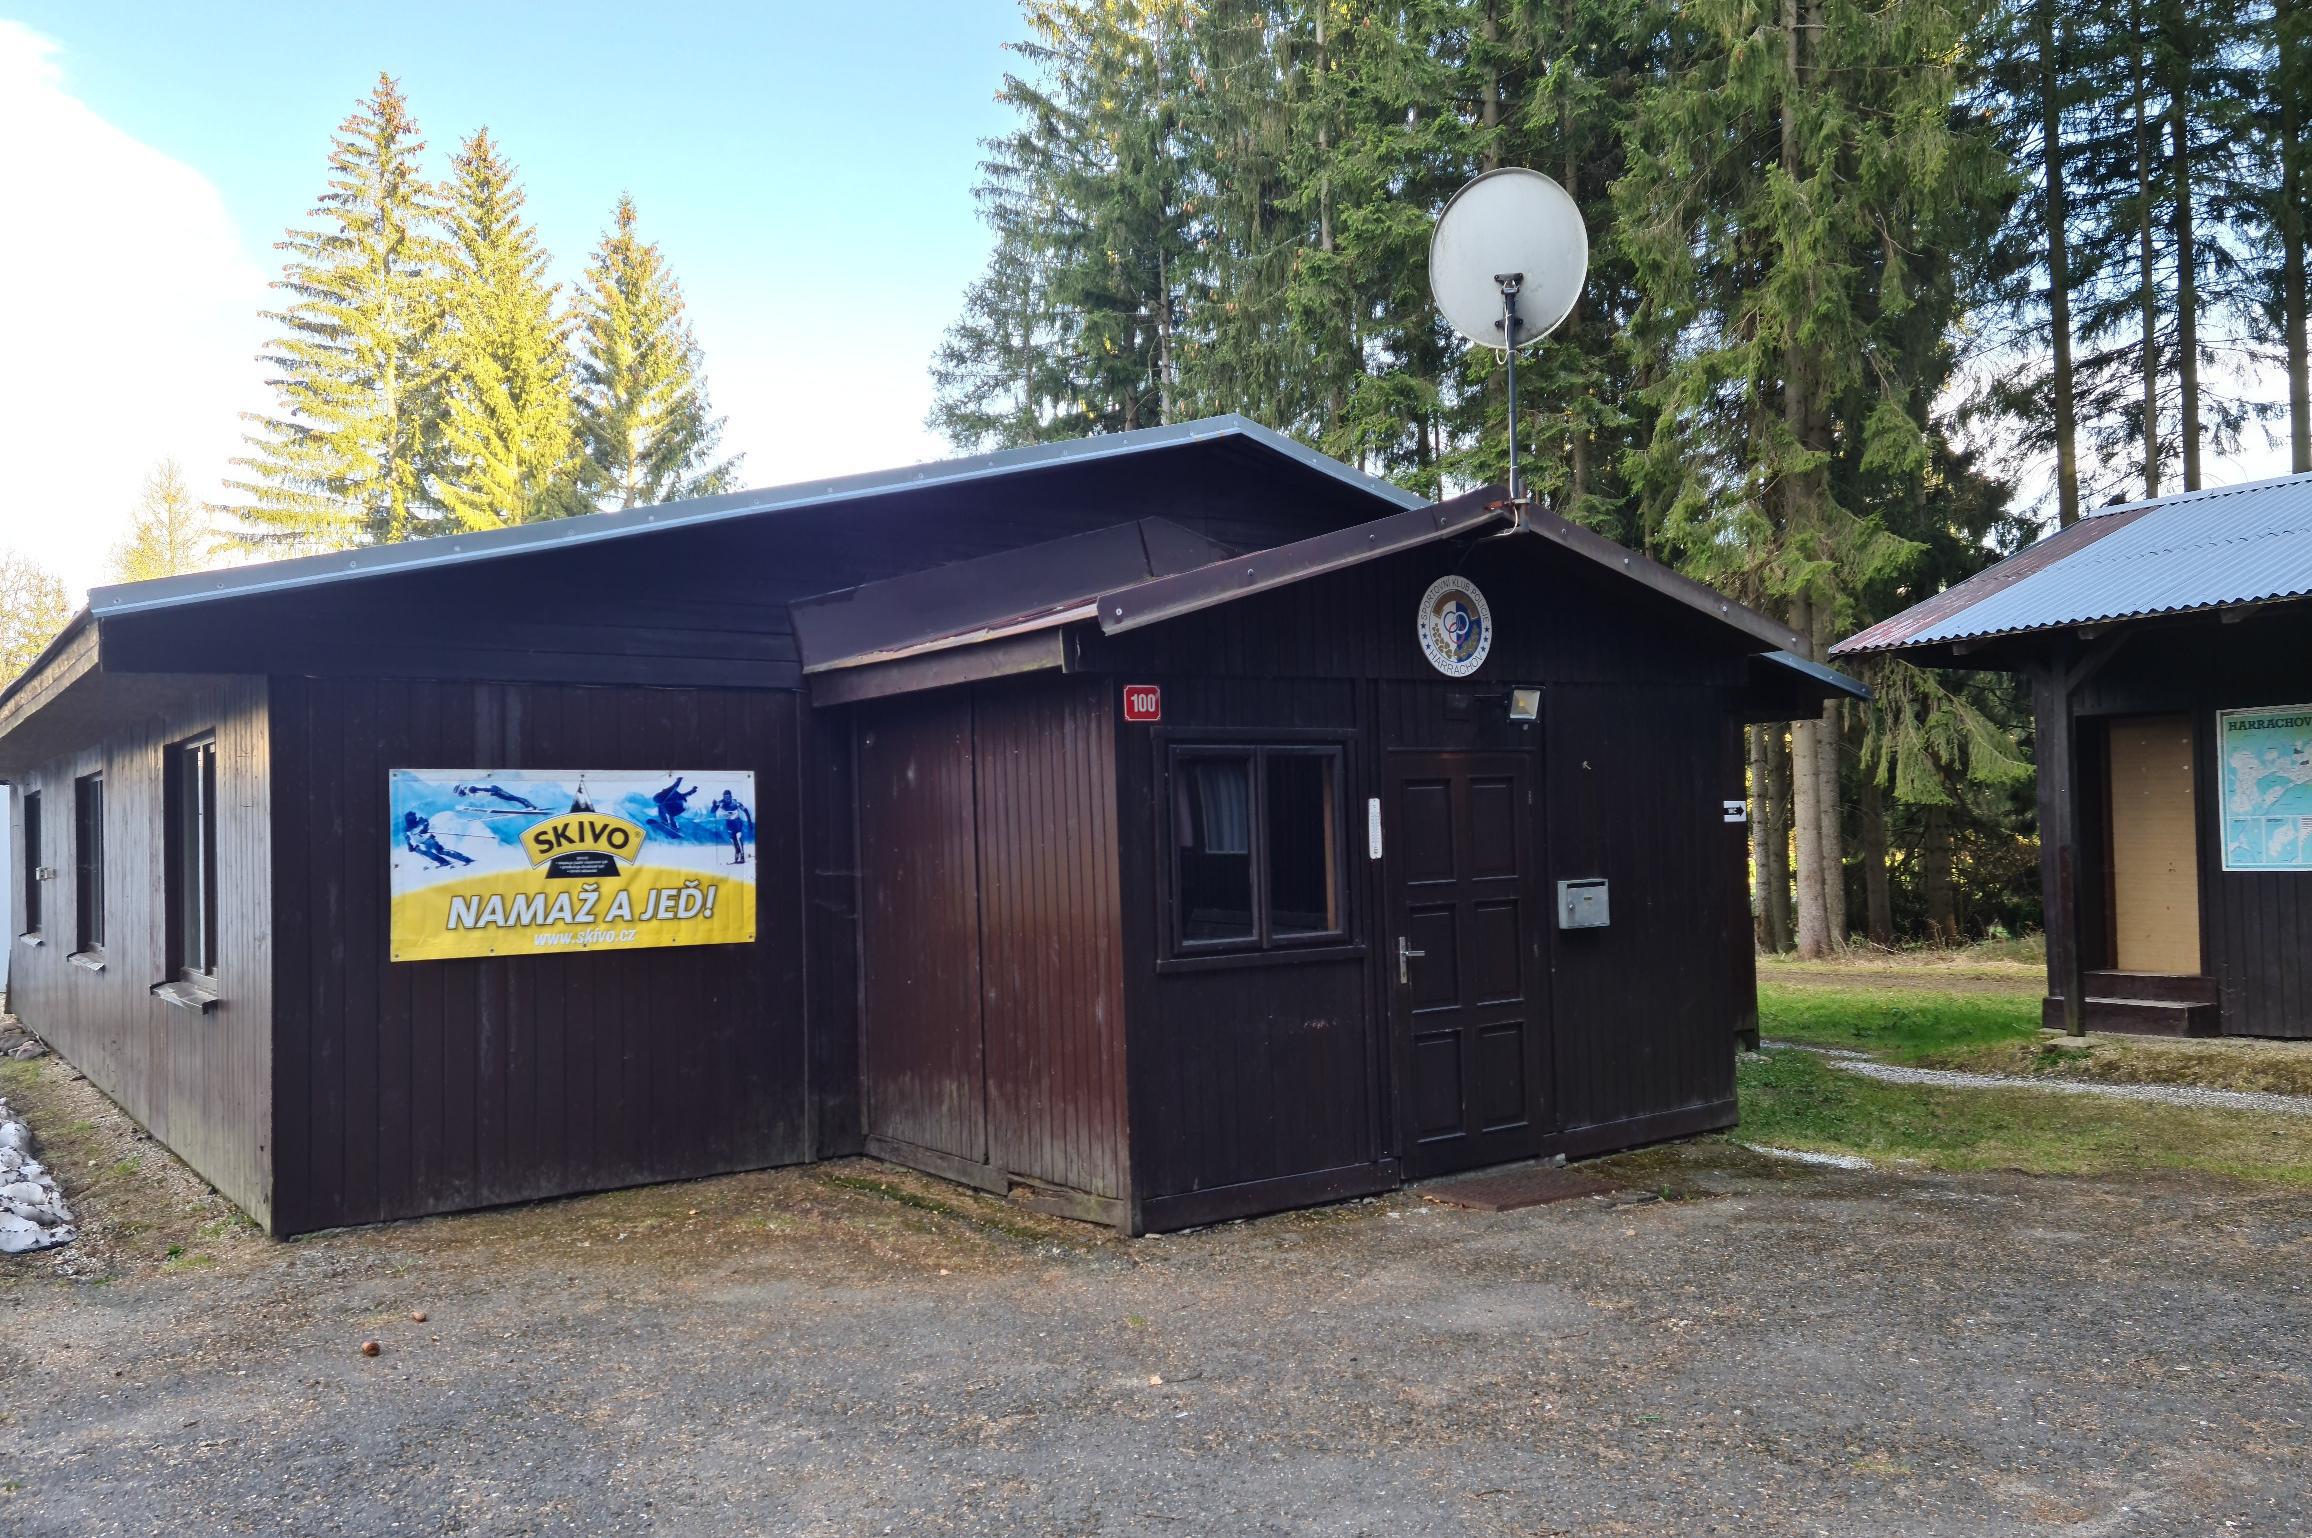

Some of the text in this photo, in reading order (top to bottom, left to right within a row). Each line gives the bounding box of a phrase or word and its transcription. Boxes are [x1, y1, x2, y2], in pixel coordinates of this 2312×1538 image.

[1451, 578, 1470, 591] KLUB
[1471, 589, 1490, 623] POLICIE
[1429, 649, 1483, 675] HARRACHOV
[1130, 693, 1156, 713] 100
[2228, 717, 2312, 731] HARRACHOV
[533, 820, 630, 855] SKIVO
[446, 880, 718, 930] NAMAŽ A JEĎ!
[534, 928, 637, 946] www.skivo.cz
